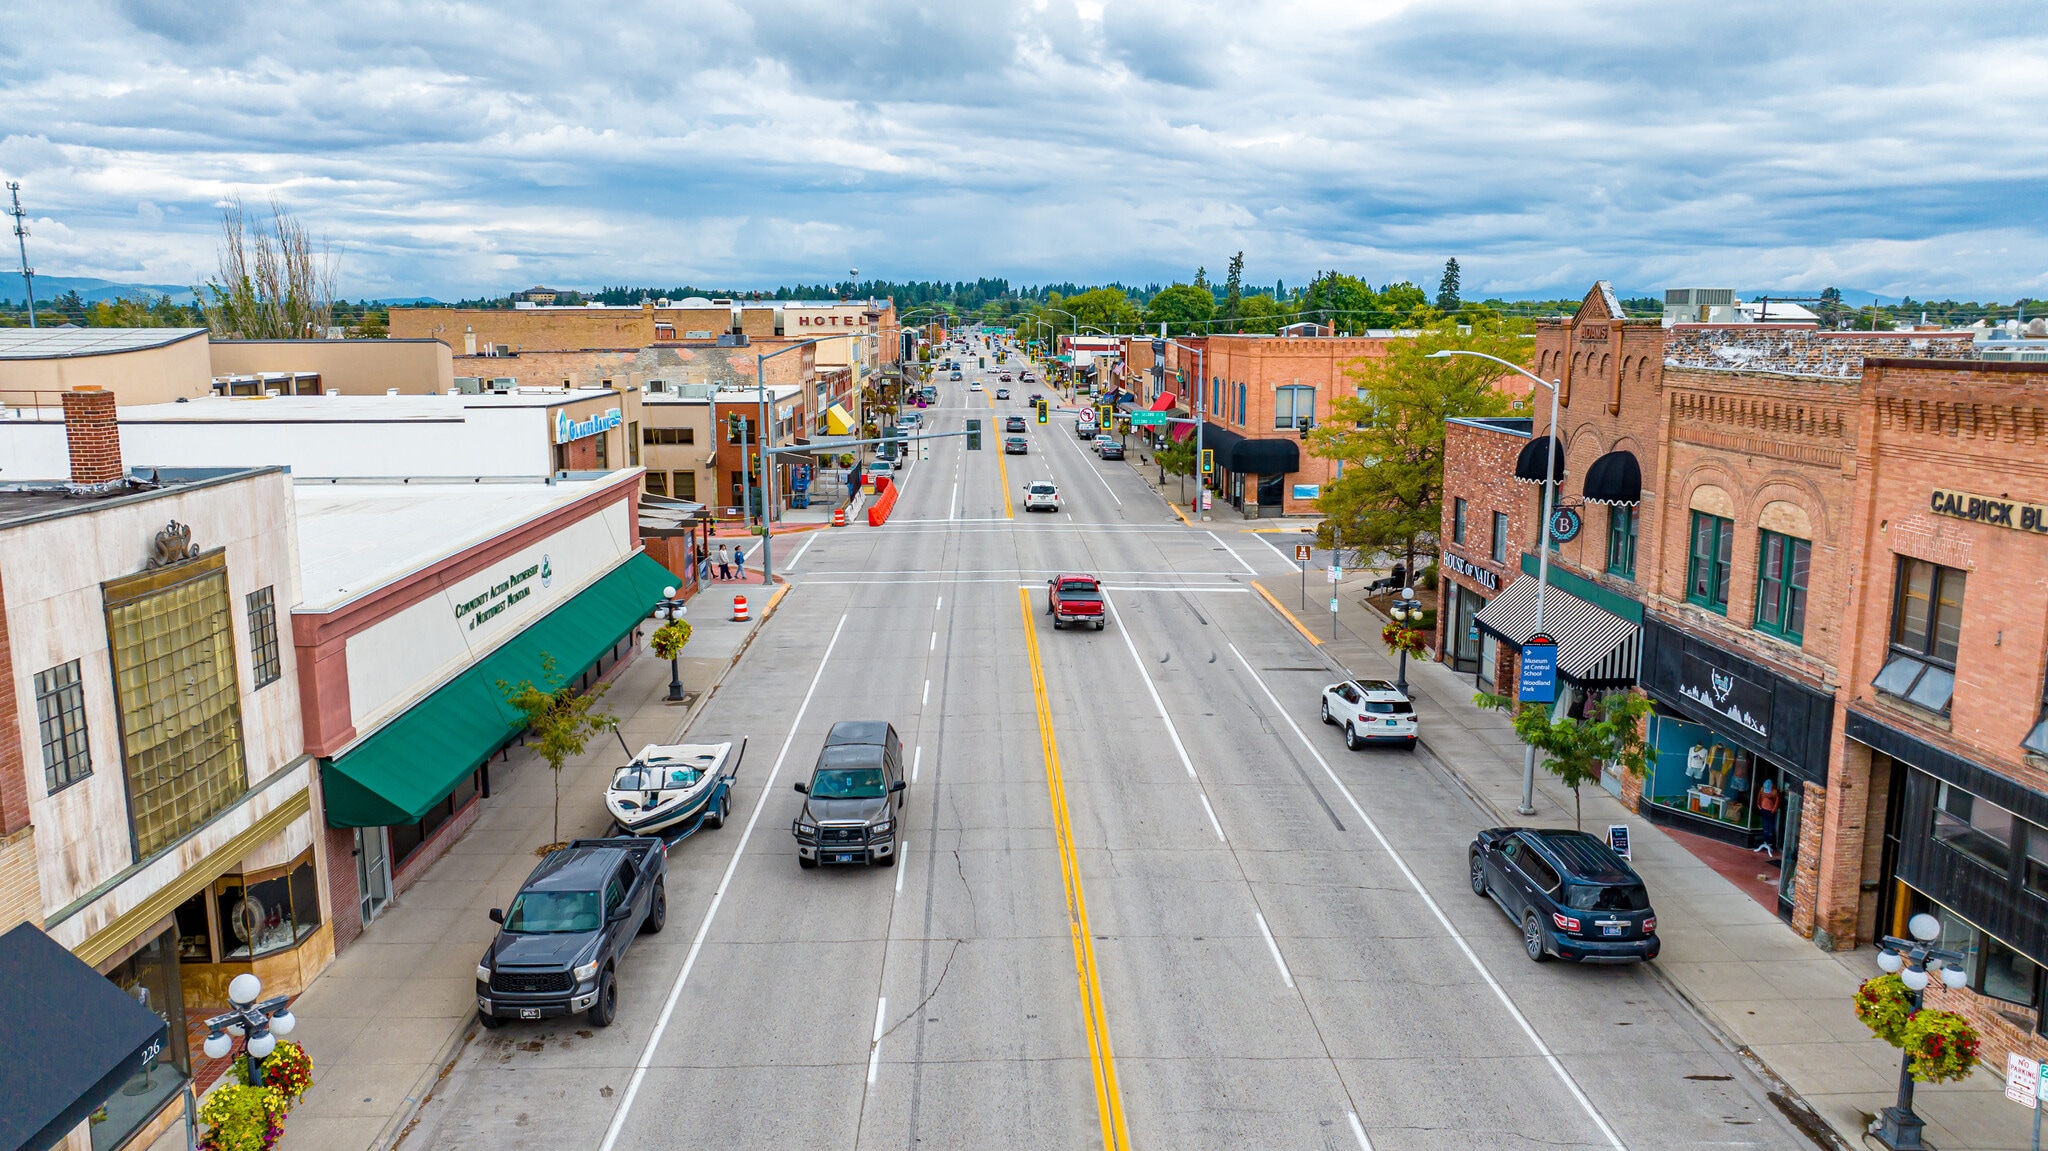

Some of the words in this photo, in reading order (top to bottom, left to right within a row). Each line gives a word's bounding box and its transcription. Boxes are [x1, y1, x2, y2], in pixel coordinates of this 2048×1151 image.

[799, 316, 868, 326] HOTEL
[1581, 326, 1608, 339] ADAMS
[1931, 491, 2013, 527] CALBICK
[1559, 517, 1570, 532] B
[1443, 551, 1465, 575] HOUSE
[1465, 564, 1473, 576] OF
[1473, 567, 1496, 590] NAILS
[455, 591, 489, 619] COMMUNITY
[490, 579, 509, 600] ACTION
[510, 564, 539, 588] PARTNERSHIP
[476, 600, 506, 626] NORTHWEST
[507, 586, 531, 608] MONTANA
[141, 1038, 160, 1065] 226
[2010, 1064, 2036, 1080] PARKING
[2018, 1059, 2029, 1069] NO
